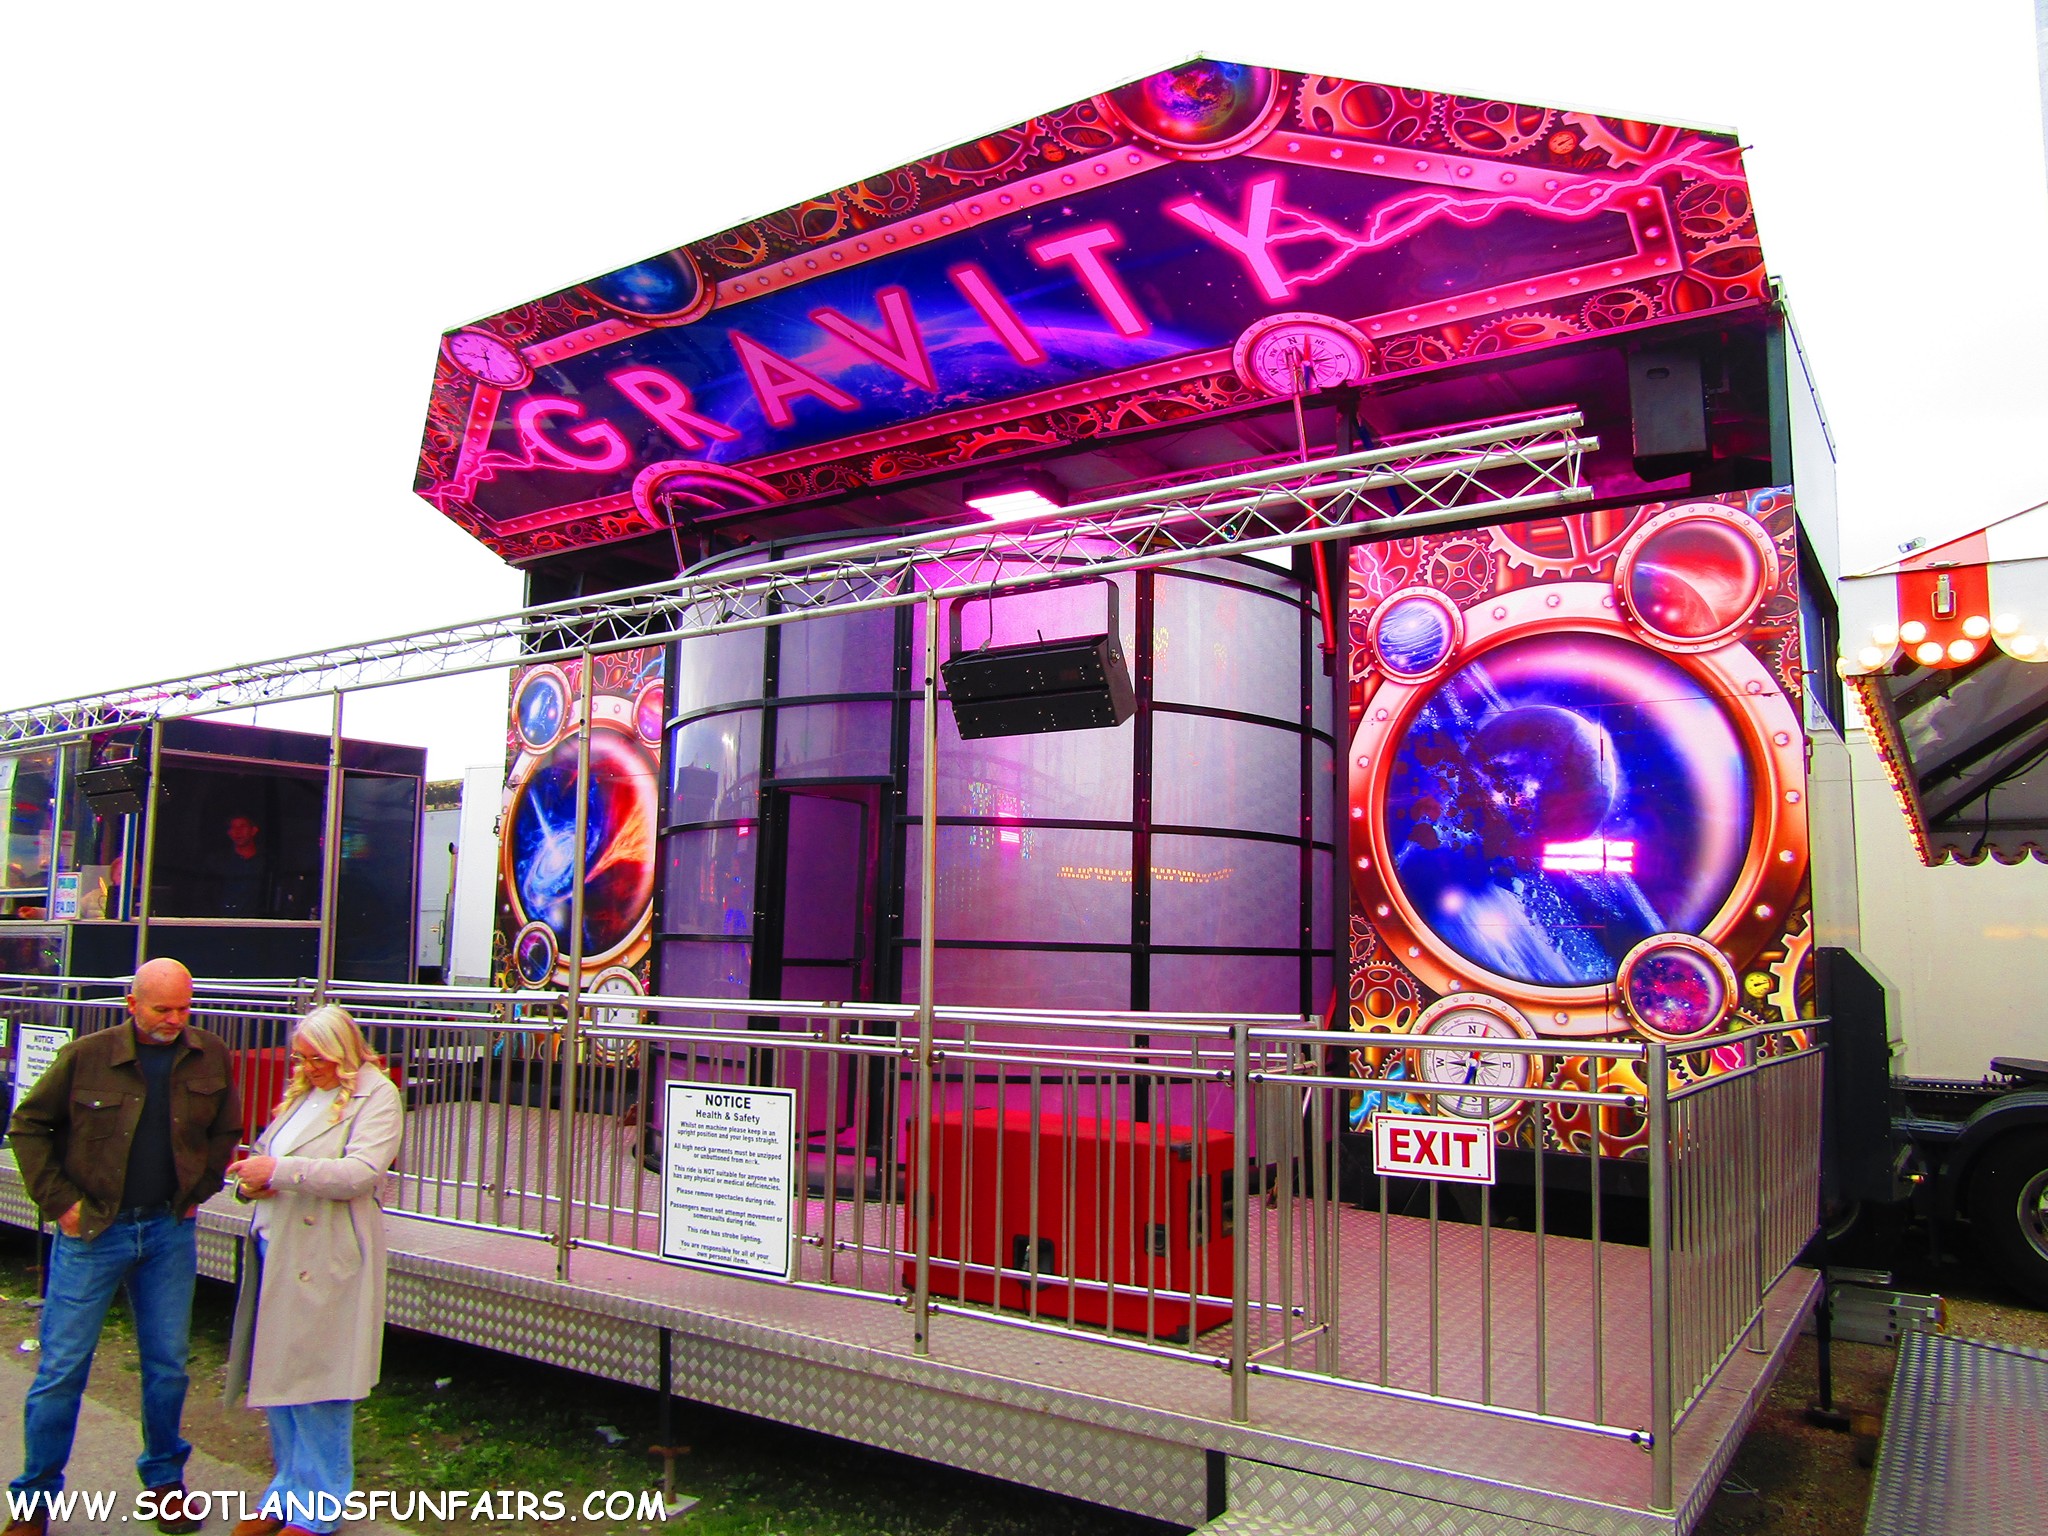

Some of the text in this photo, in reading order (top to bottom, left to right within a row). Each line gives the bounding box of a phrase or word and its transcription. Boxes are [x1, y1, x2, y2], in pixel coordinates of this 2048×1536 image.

[517, 179, 1291, 472] GRAVITY
[1468, 1025, 1477, 1034] N
[705, 1094, 751, 1109] NOTICE
[696, 1110, 760, 1125] Health & Safety
[681, 1121, 696, 1129] Whilst
[705, 1123, 727, 1131] machine
[729, 1126, 746, 1134] please
[748, 1128, 760, 1136] keep
[697, 1130, 717, 1138] position
[756, 1136, 779, 1145] straight.
[708, 1147, 732, 1155] garments
[757, 1152, 781, 1160] unzipped
[1390, 1128, 1478, 1168] EXIT
[700, 1153, 730, 1162] unbuttoned
[731, 1155, 743, 1163] from
[694, 1175, 715, 1183] physical
[746, 1181, 780, 1190] deficiencies.
[716, 1170, 737, 1178] suitable
[748, 1174, 766, 1182] anyone
[677, 1187, 693, 1195] Please
[715, 1193, 743, 1201] spectacles
[746, 1196, 762, 1205] during
[670, 1201, 699, 1211] Passengers
[725, 1208, 745, 1217] attempt
[747, 1212, 775, 1221] movement
[693, 1212, 724, 1222] somersaults
[727, 1217, 743, 1226] during
[722, 1231, 738, 1239] strobe
[740, 1234, 762, 1244] lighting.
[701, 1243, 731, 1253] responsible
[709, 1252, 732, 1262] personal
[733, 1256, 749, 1264] items.
